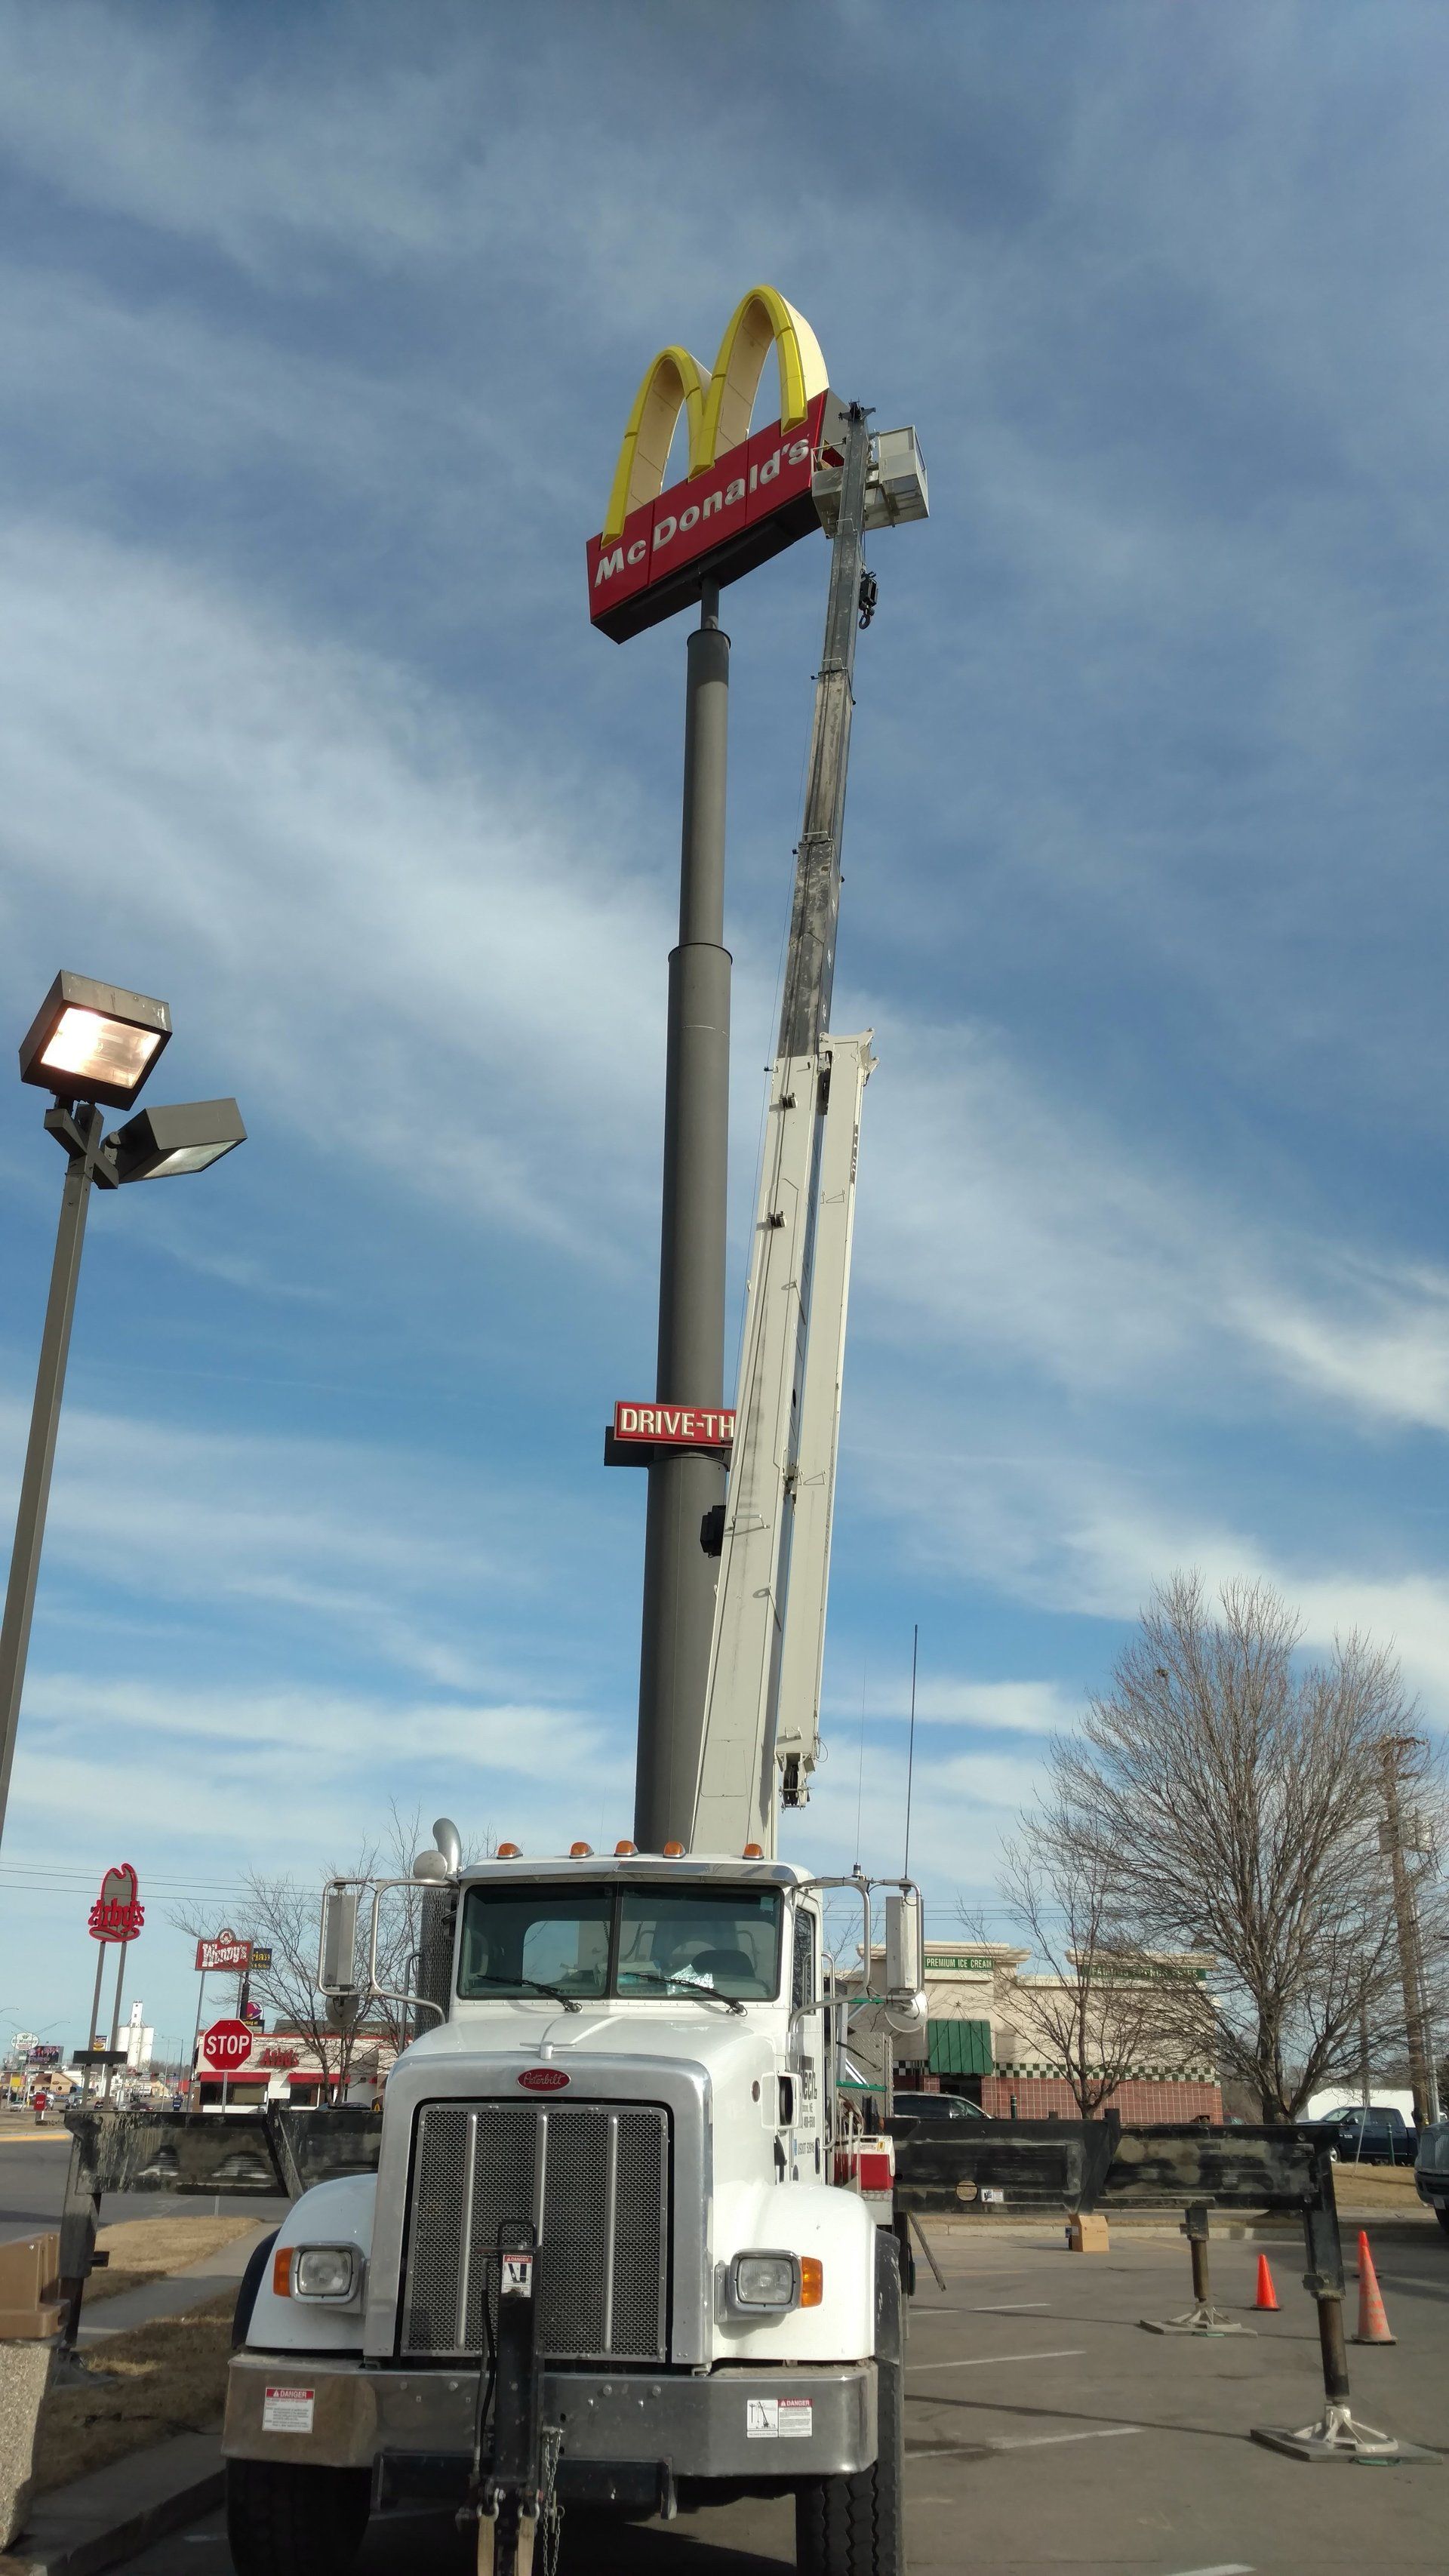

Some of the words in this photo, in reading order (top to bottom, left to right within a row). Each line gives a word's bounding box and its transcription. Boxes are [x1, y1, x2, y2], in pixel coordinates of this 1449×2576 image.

[594, 437, 810, 587] McDonald's
[88, 1898, 145, 1934] Arby's
[202, 1944, 248, 1968] Wendy's
[926, 1958, 955, 1968] PREMIUM
[958, 1959, 968, 1968] ICE
[970, 1959, 992, 1968] CREAM
[206, 2035, 250, 2055] STOP
[259, 2047, 300, 2067] Arby's
[523, 2071, 566, 2085] Peterbilt
[280, 2390, 307, 2399] DANGER
